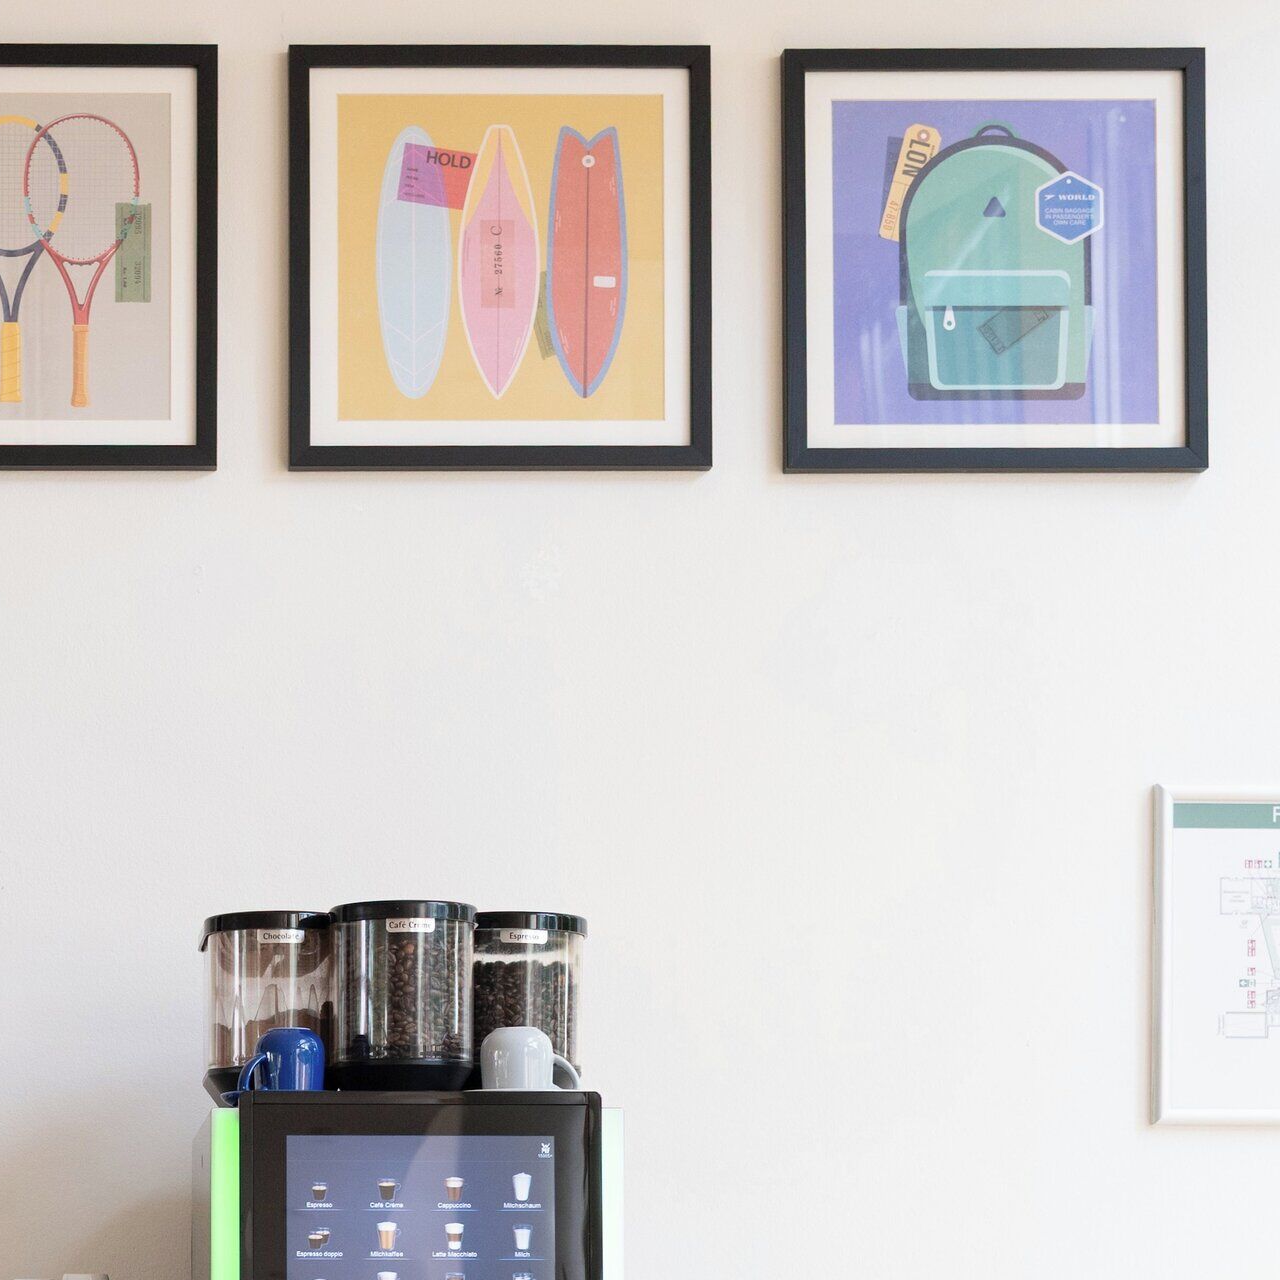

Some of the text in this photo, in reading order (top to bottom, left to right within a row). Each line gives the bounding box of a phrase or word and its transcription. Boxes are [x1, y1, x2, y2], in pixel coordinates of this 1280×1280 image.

[426, 150, 471, 168] HOLD
[902, 138, 930, 177] LON
[389, 920, 406, 929] Café
[262, 931, 300, 940] Chocolate
[509, 932, 540, 941] Espresso
